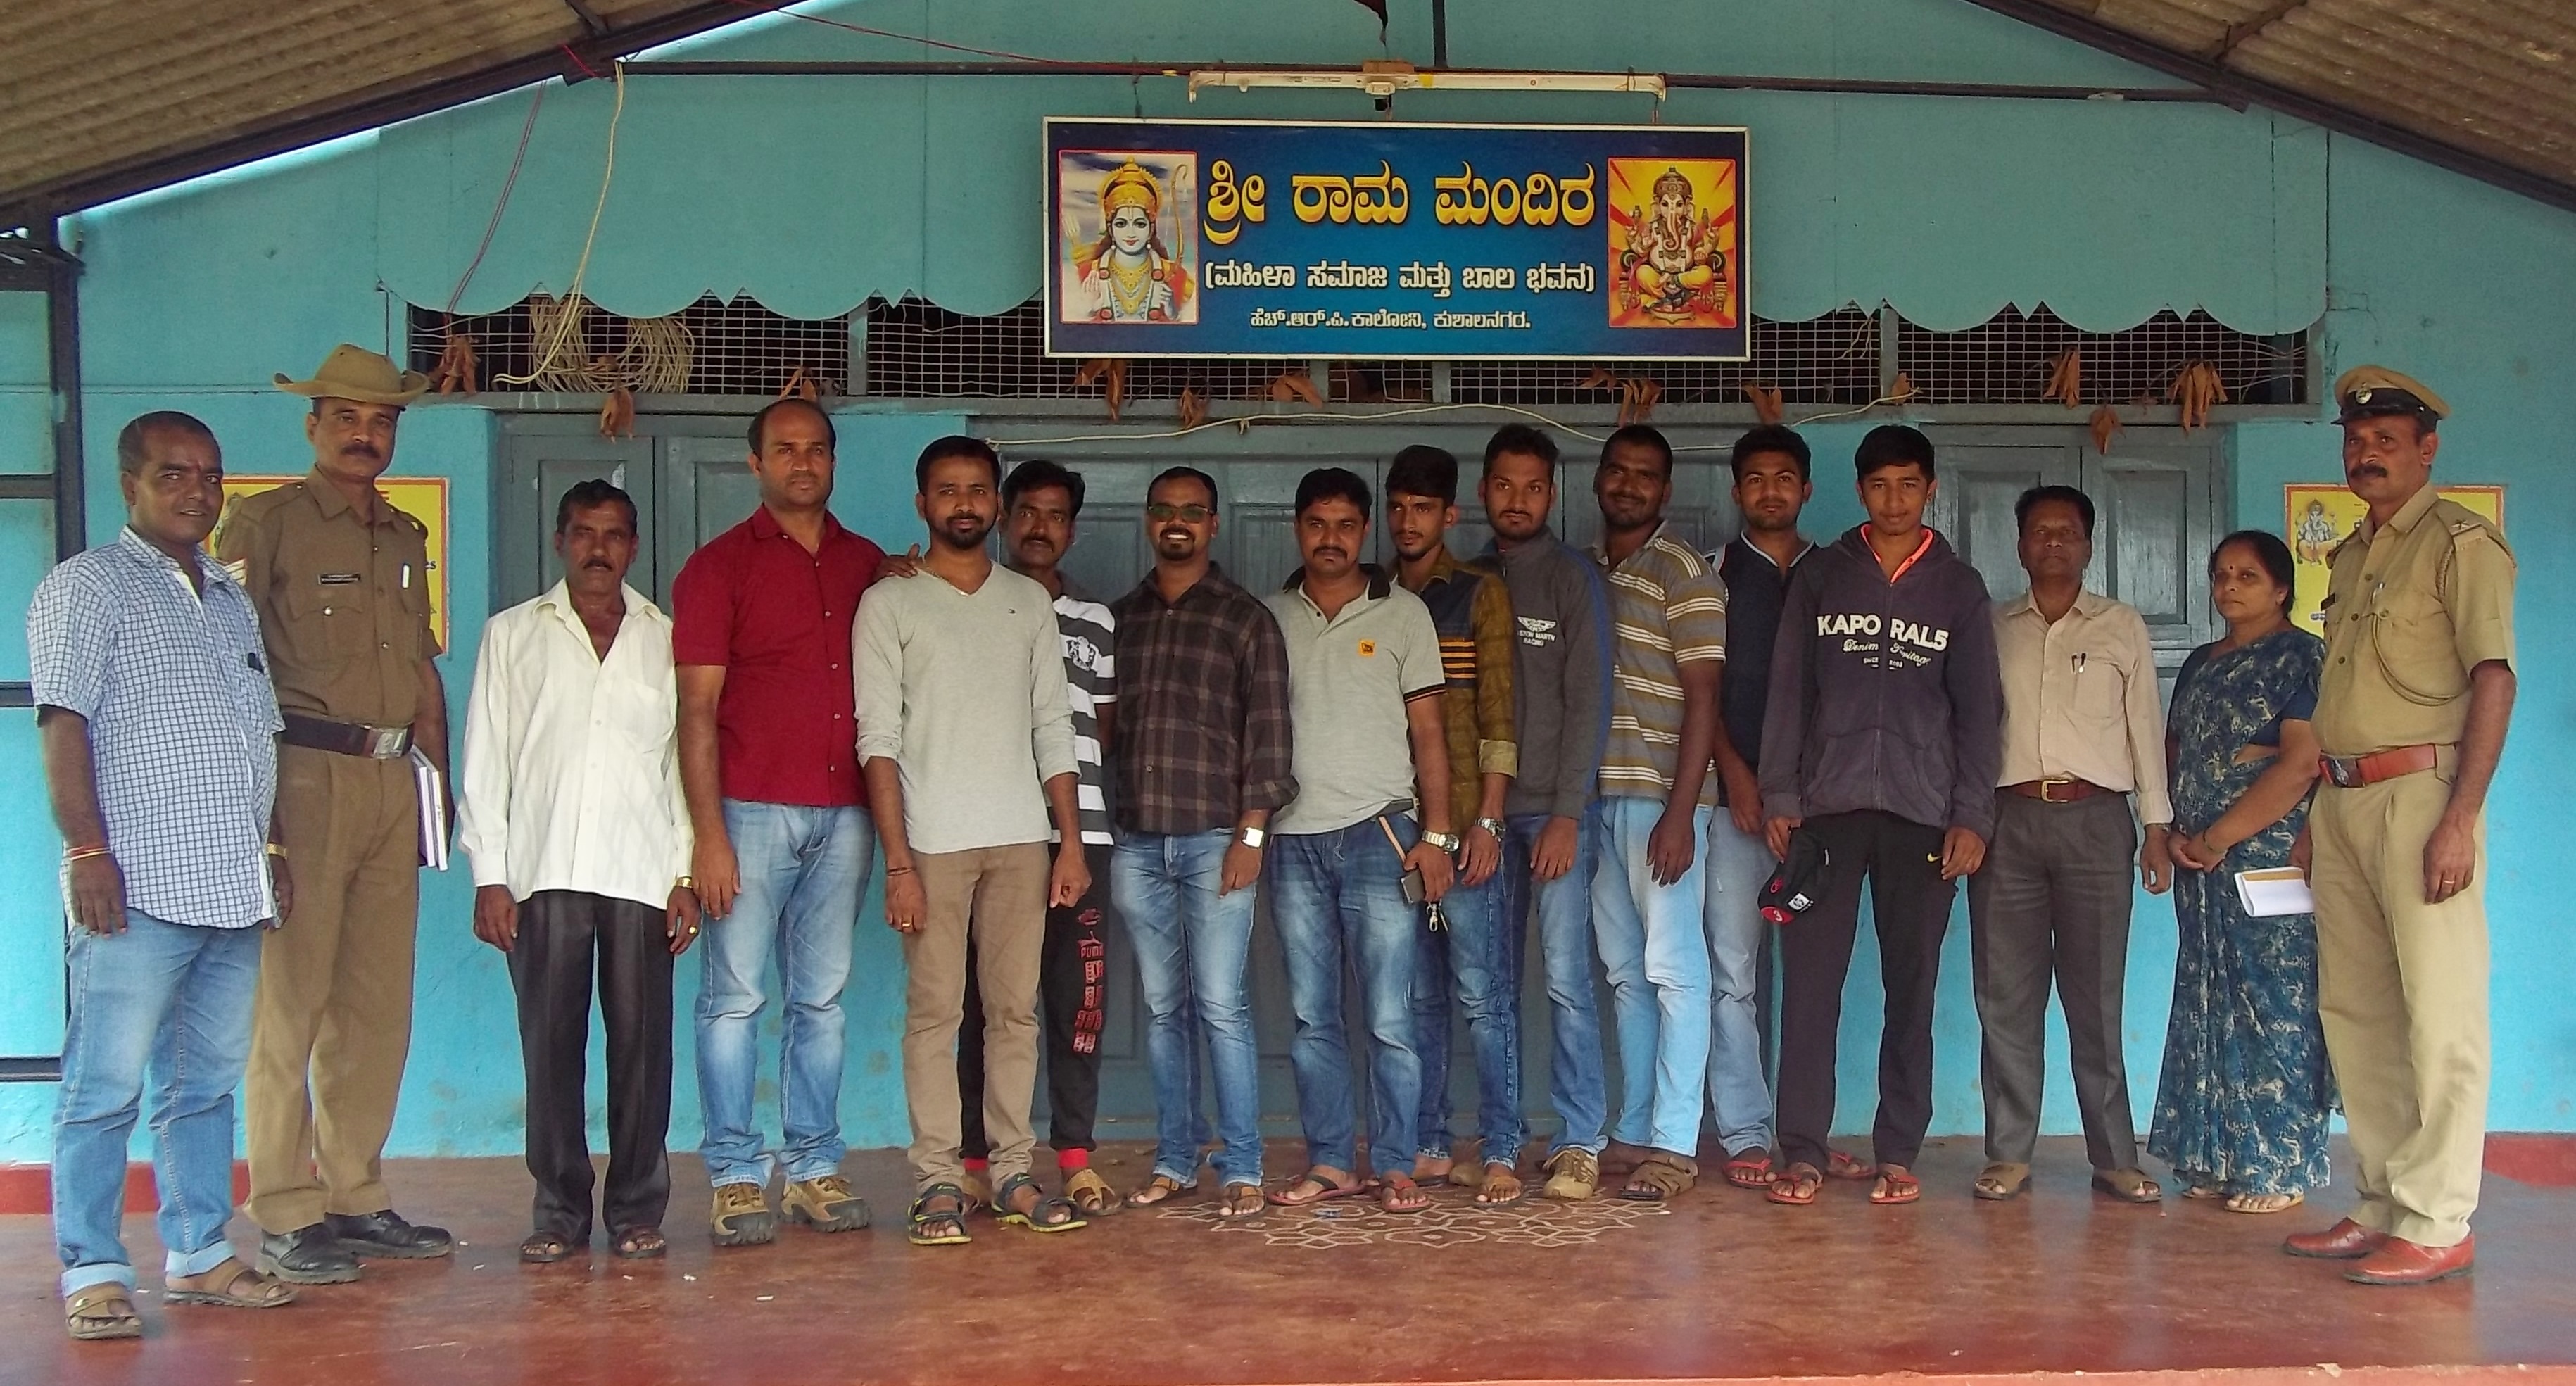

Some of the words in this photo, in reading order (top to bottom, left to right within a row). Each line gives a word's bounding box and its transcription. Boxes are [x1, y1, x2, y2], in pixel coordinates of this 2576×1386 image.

[1203, 160, 1265, 244] ಶ್ರೀ
[1292, 159, 1408, 225] ರಾಮ
[1434, 160, 1596, 226] ಮಂದಿರ
[1205, 259, 1296, 289] (ಮಹಿಳಾ
[1306, 260, 1388, 288] ಸಮಾಜ
[1399, 261, 1451, 298] ಮತ್ತು
[1462, 267, 1515, 289] ಬಾಲ
[1526, 262, 1596, 293] ಭವನ)
[1433, 310, 1532, 329] ಕುಶಾಲನಗರ.
[1817, 614, 1881, 636] KAPO
